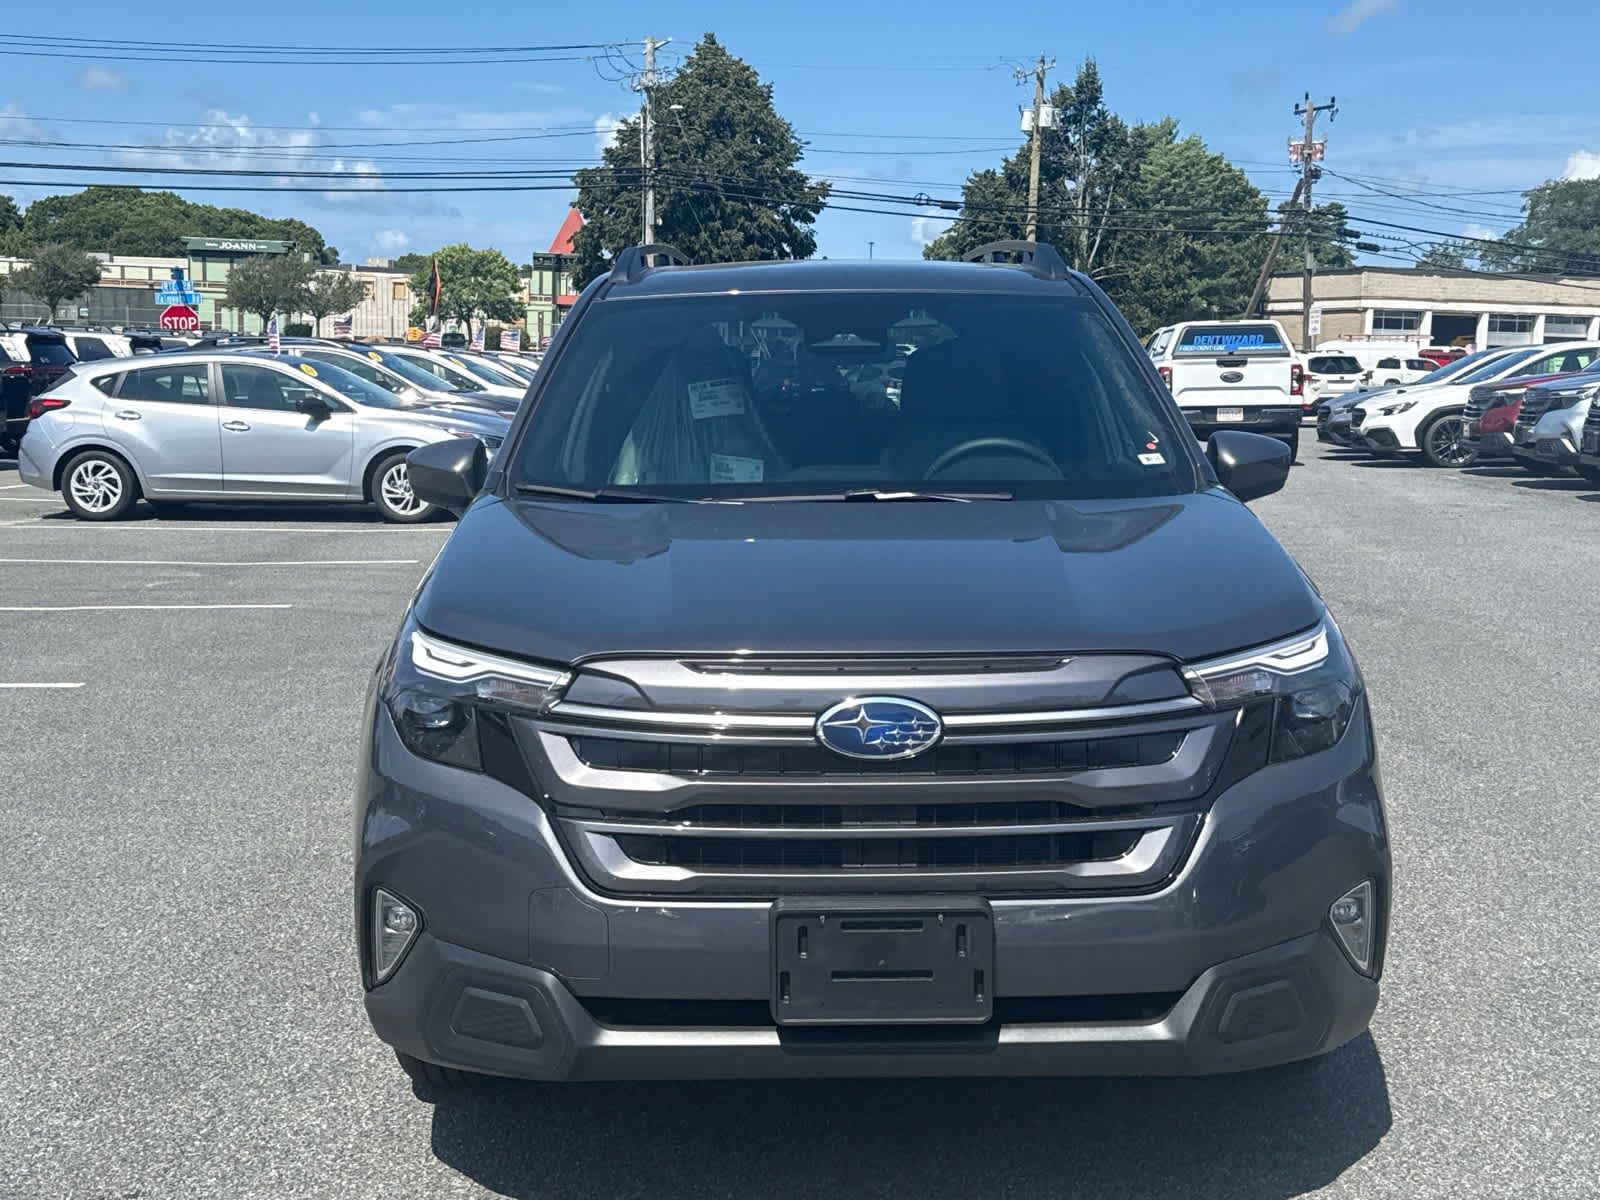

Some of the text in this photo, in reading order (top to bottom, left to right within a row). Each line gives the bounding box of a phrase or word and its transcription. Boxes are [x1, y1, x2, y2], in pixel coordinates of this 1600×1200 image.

[163, 317, 197, 330] STOP
[1193, 335, 1264, 345] DENT WIZARD
